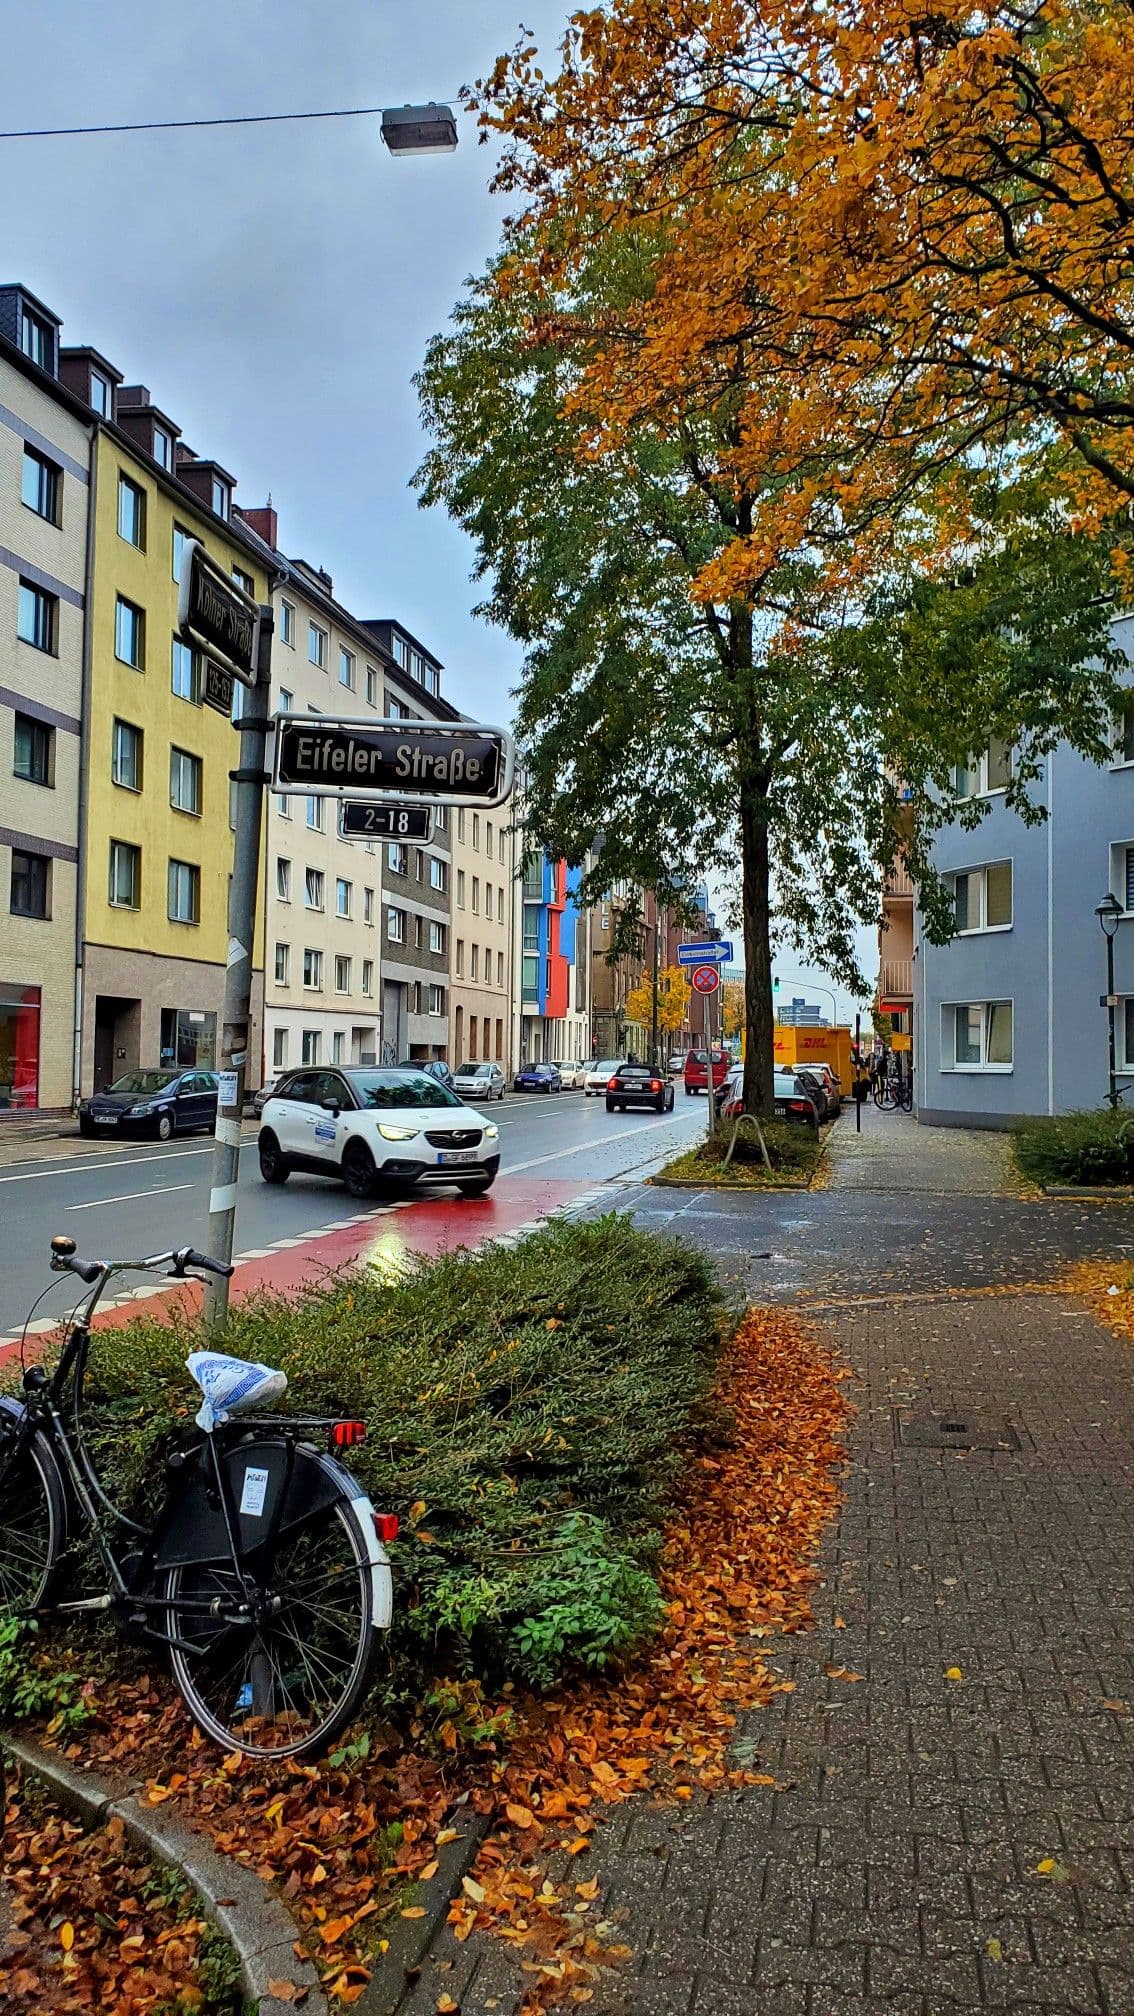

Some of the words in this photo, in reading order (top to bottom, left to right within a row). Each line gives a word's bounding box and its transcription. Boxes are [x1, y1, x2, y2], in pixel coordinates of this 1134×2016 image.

[297, 737, 382, 774] Eifeler
[395, 744, 481, 785] Straße
[364, 808, 409, 834] 2-18
[803, 1037, 827, 1048] DHL
